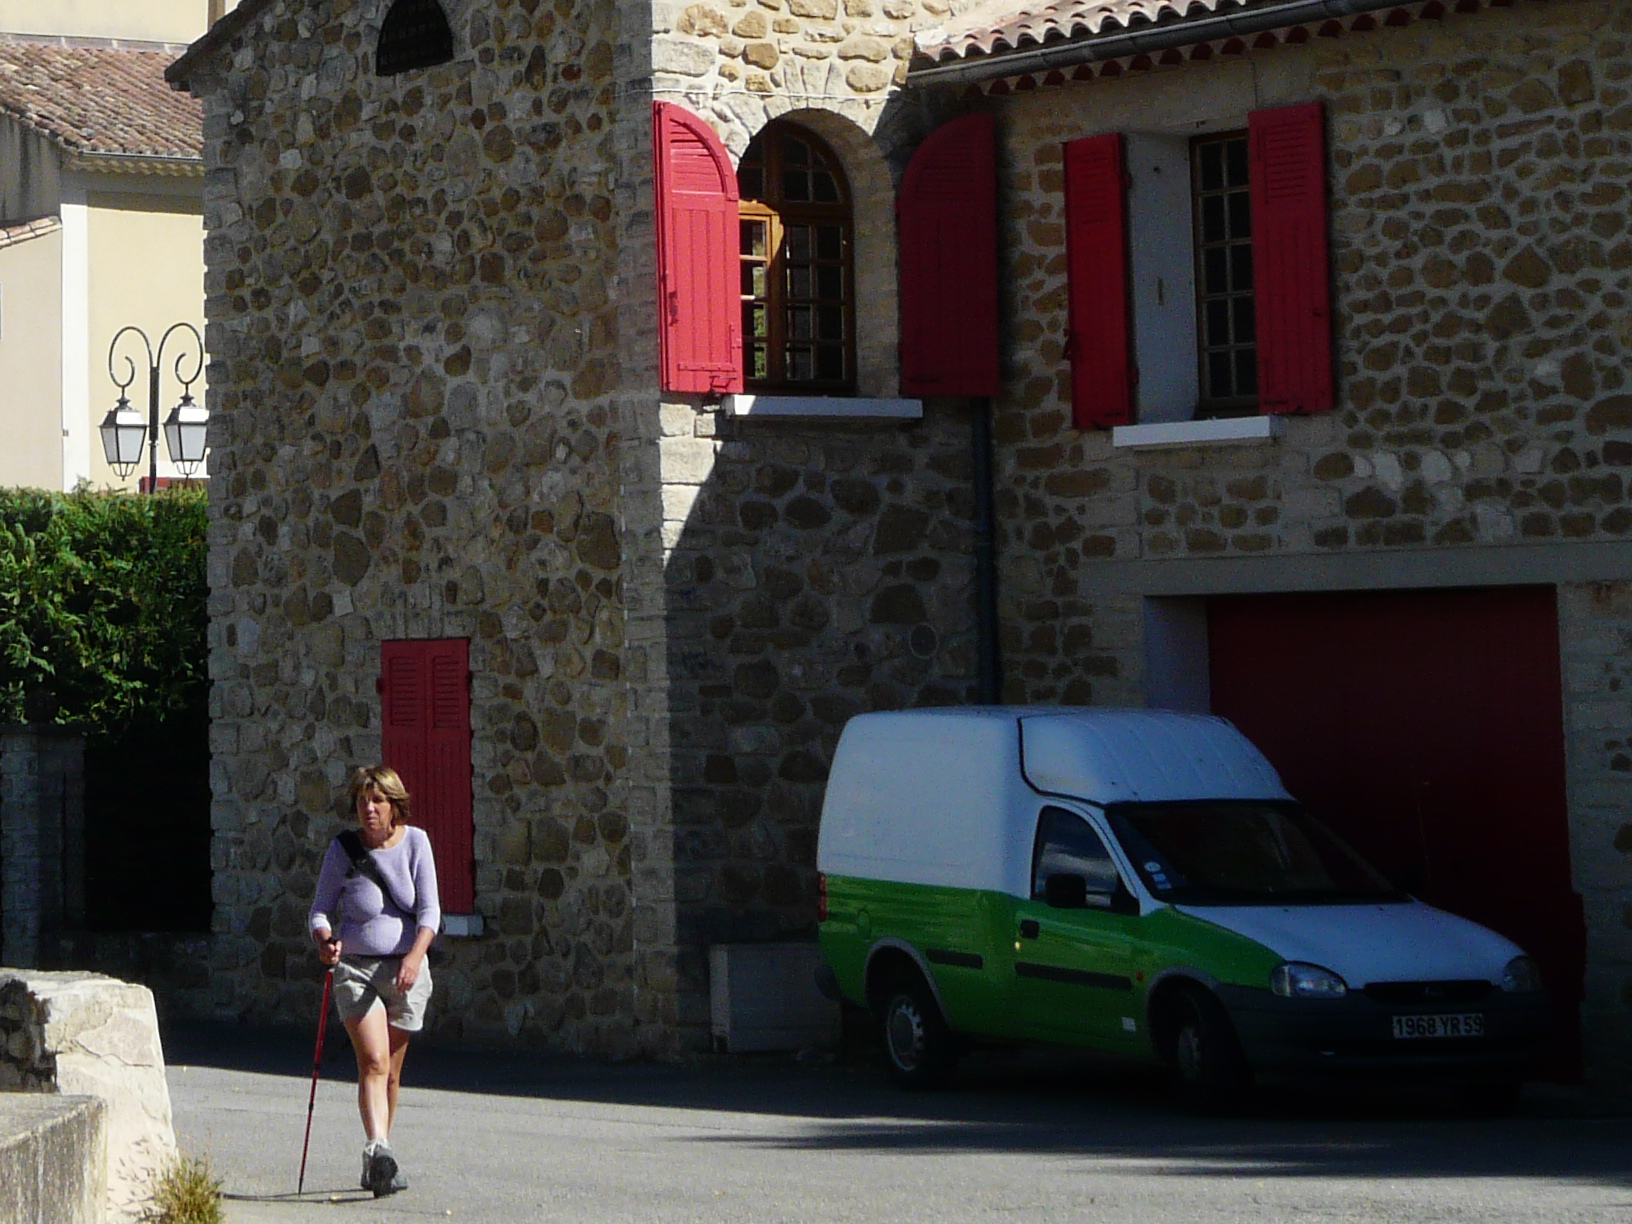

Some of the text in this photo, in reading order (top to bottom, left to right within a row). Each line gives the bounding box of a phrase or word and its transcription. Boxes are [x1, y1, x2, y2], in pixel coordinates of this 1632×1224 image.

[1396, 1015, 1484, 1036] 1968 YR 59
